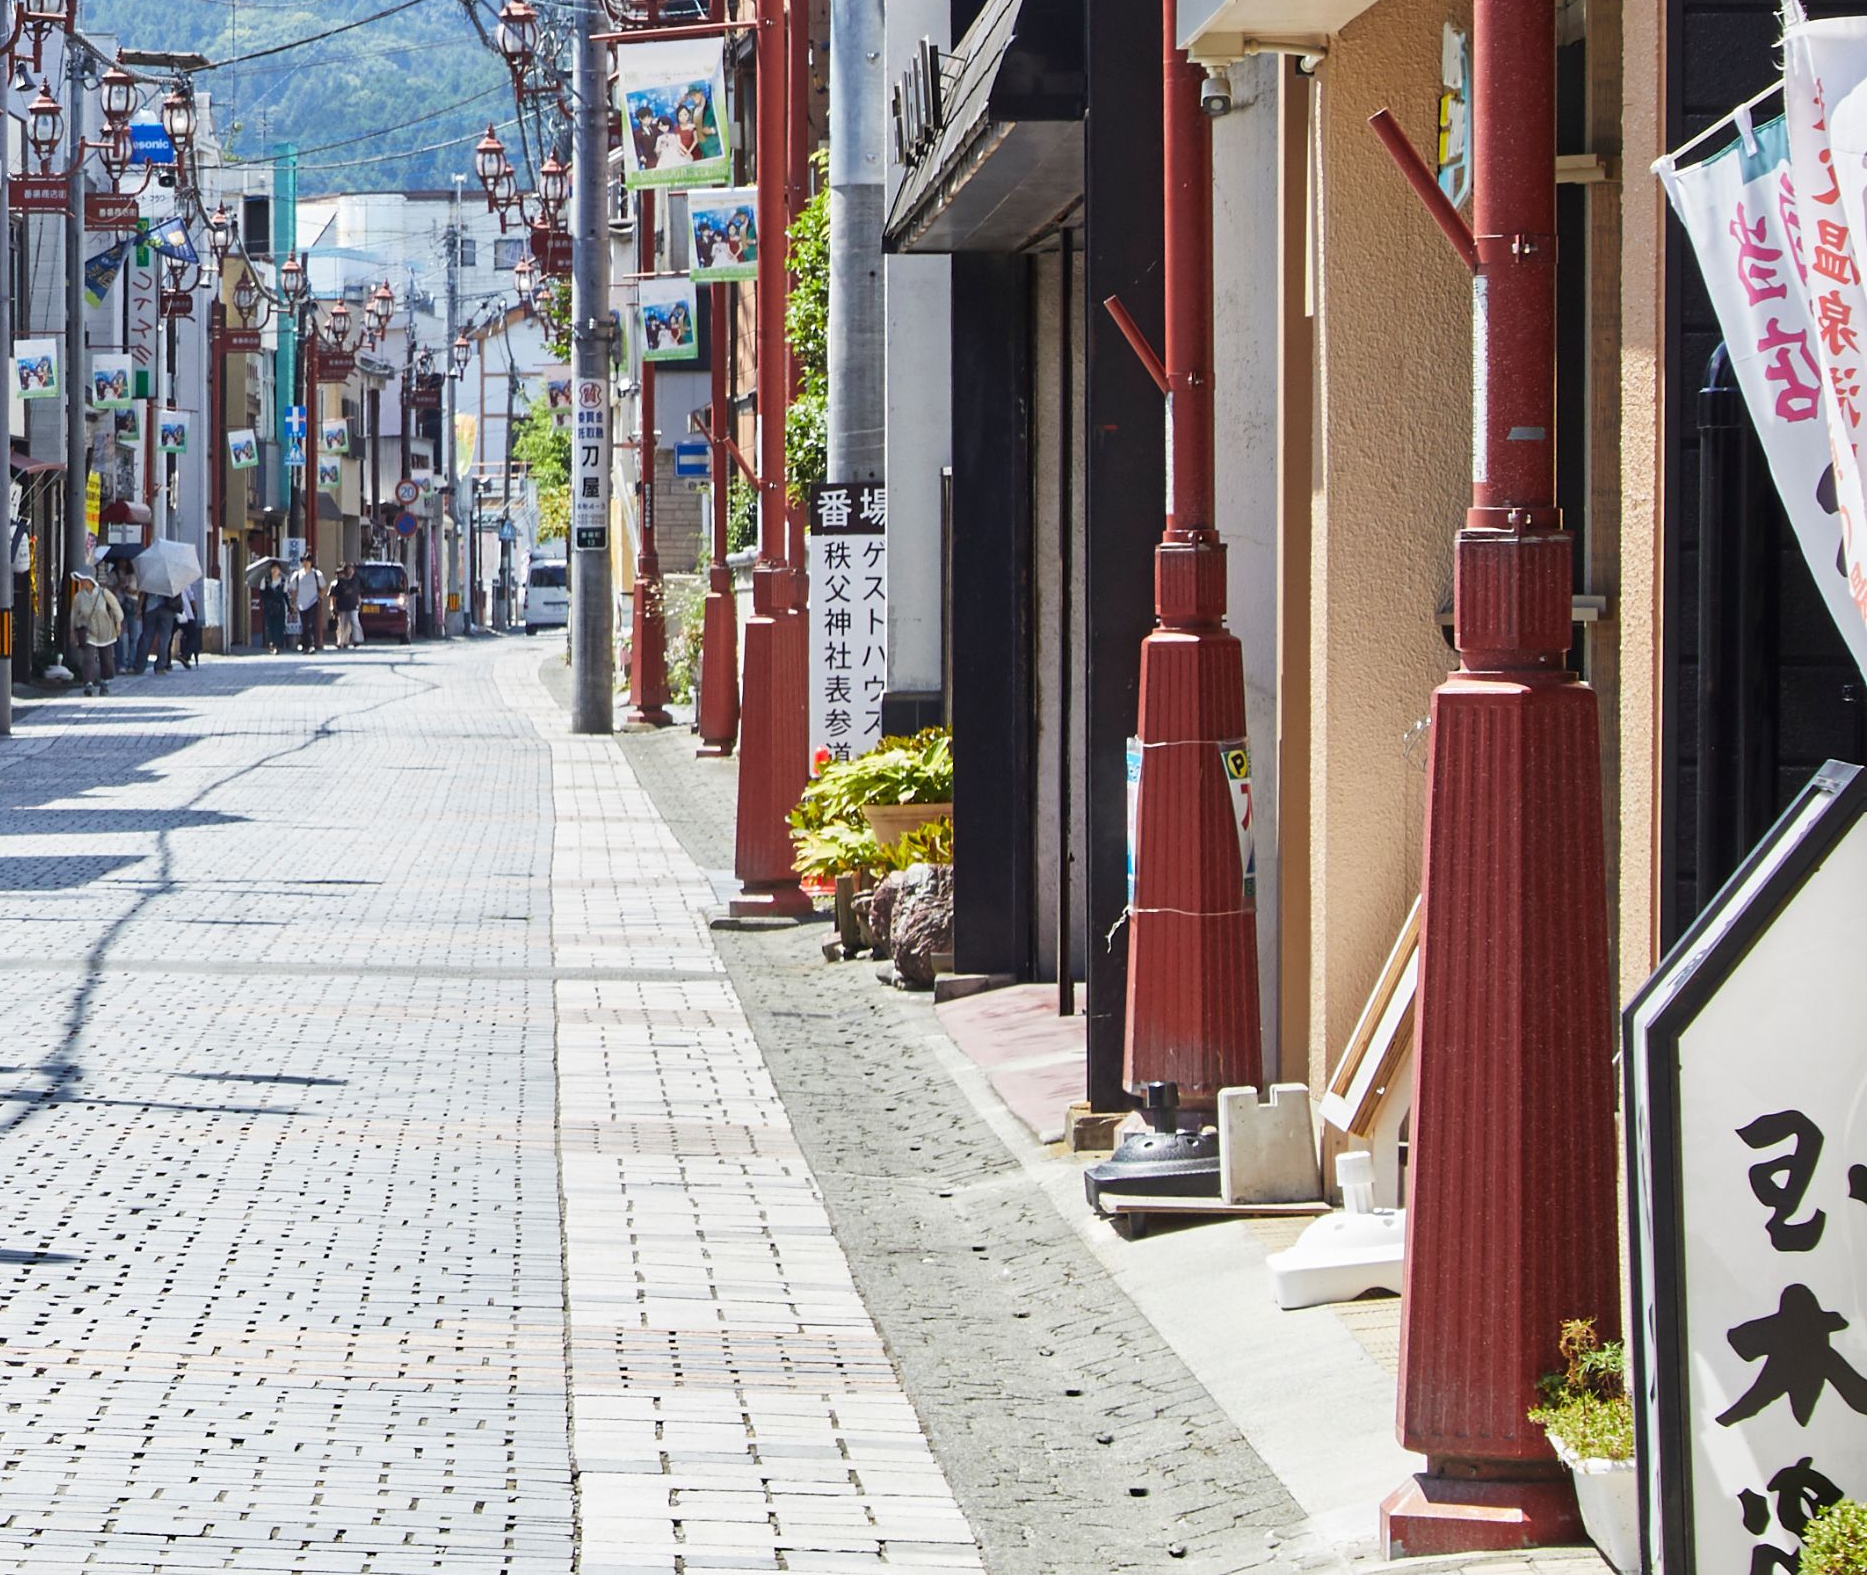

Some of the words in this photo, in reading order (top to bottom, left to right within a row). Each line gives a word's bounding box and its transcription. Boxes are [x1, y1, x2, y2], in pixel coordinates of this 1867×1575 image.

[401, 486, 414, 499] 20
[582, 446, 599, 498] 刀屋
[824, 541, 852, 761] 秩父神社表参道
